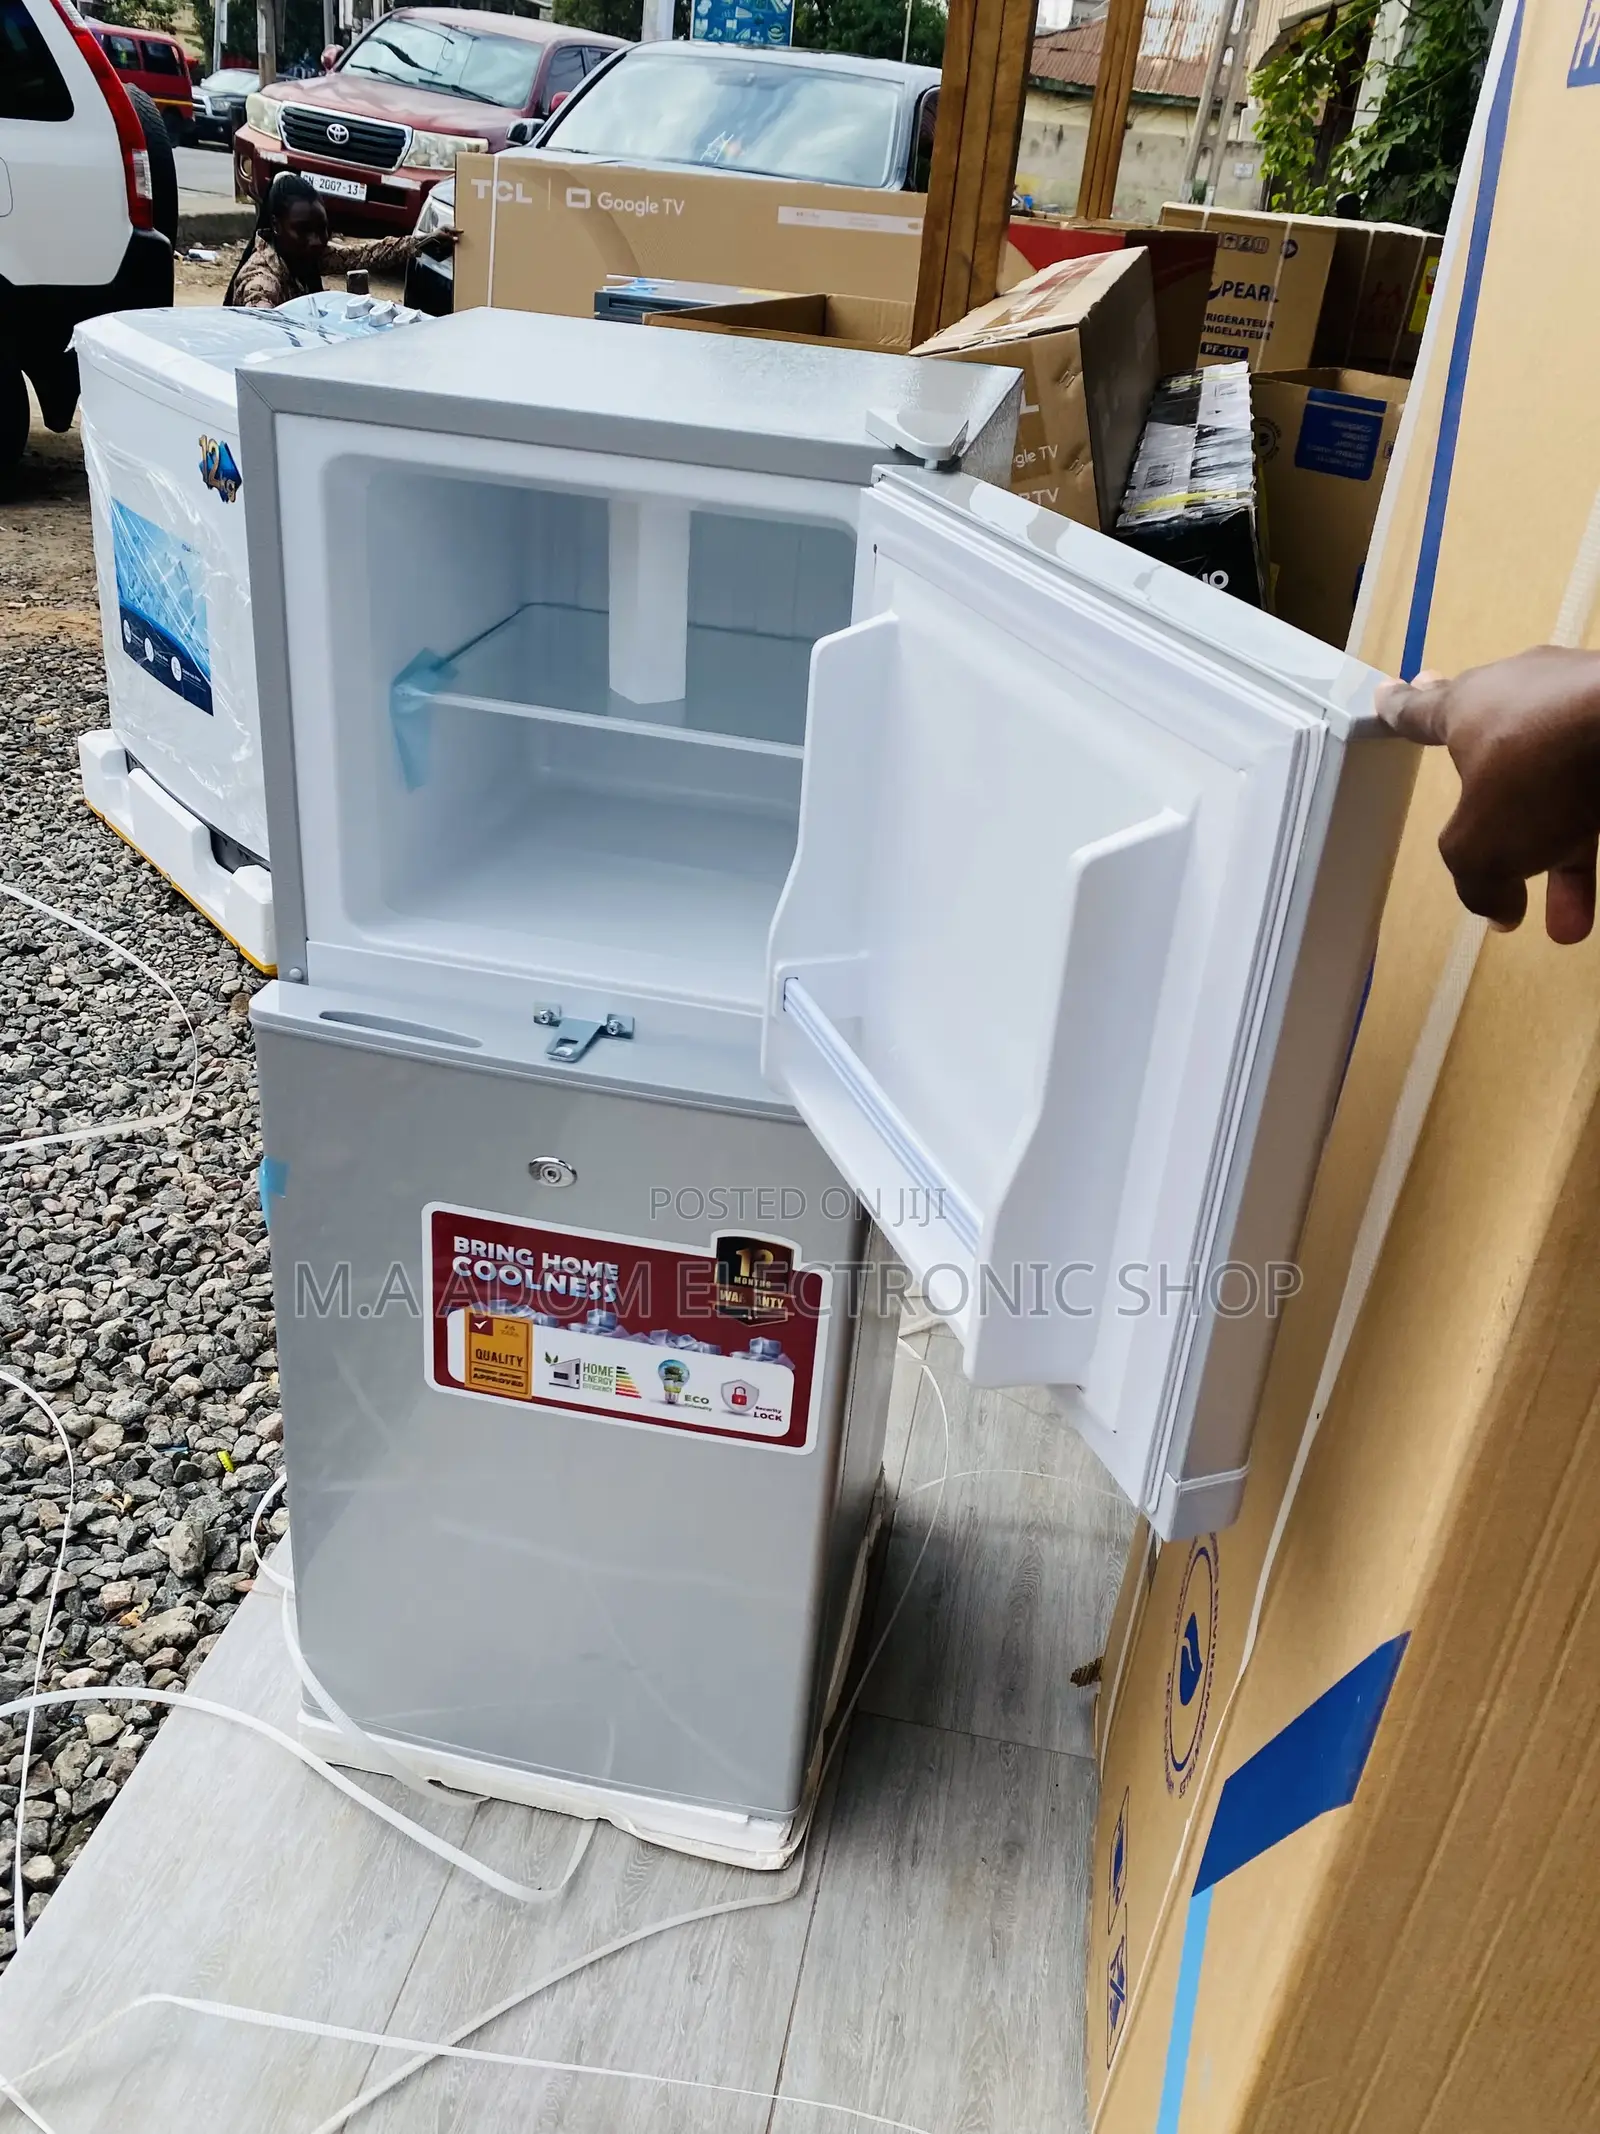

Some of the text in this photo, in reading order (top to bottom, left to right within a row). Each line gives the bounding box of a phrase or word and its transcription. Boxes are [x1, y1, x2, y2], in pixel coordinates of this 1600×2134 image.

[470, 178, 686, 217] TCL Google TV
[1012, 444, 1059, 468] gle TV
[453, 1236, 619, 1281] BRING HOME
[452, 1256, 618, 1303] COOLNESS
[719, 1289, 785, 1310] WAANTY
[475, 1348, 524, 1367] QUALITY
[583, 1361, 614, 1377] HOME
[582, 1374, 614, 1387] ENERGY
[684, 1394, 710, 1405] ECO
[753, 1411, 783, 1422] LOCK
